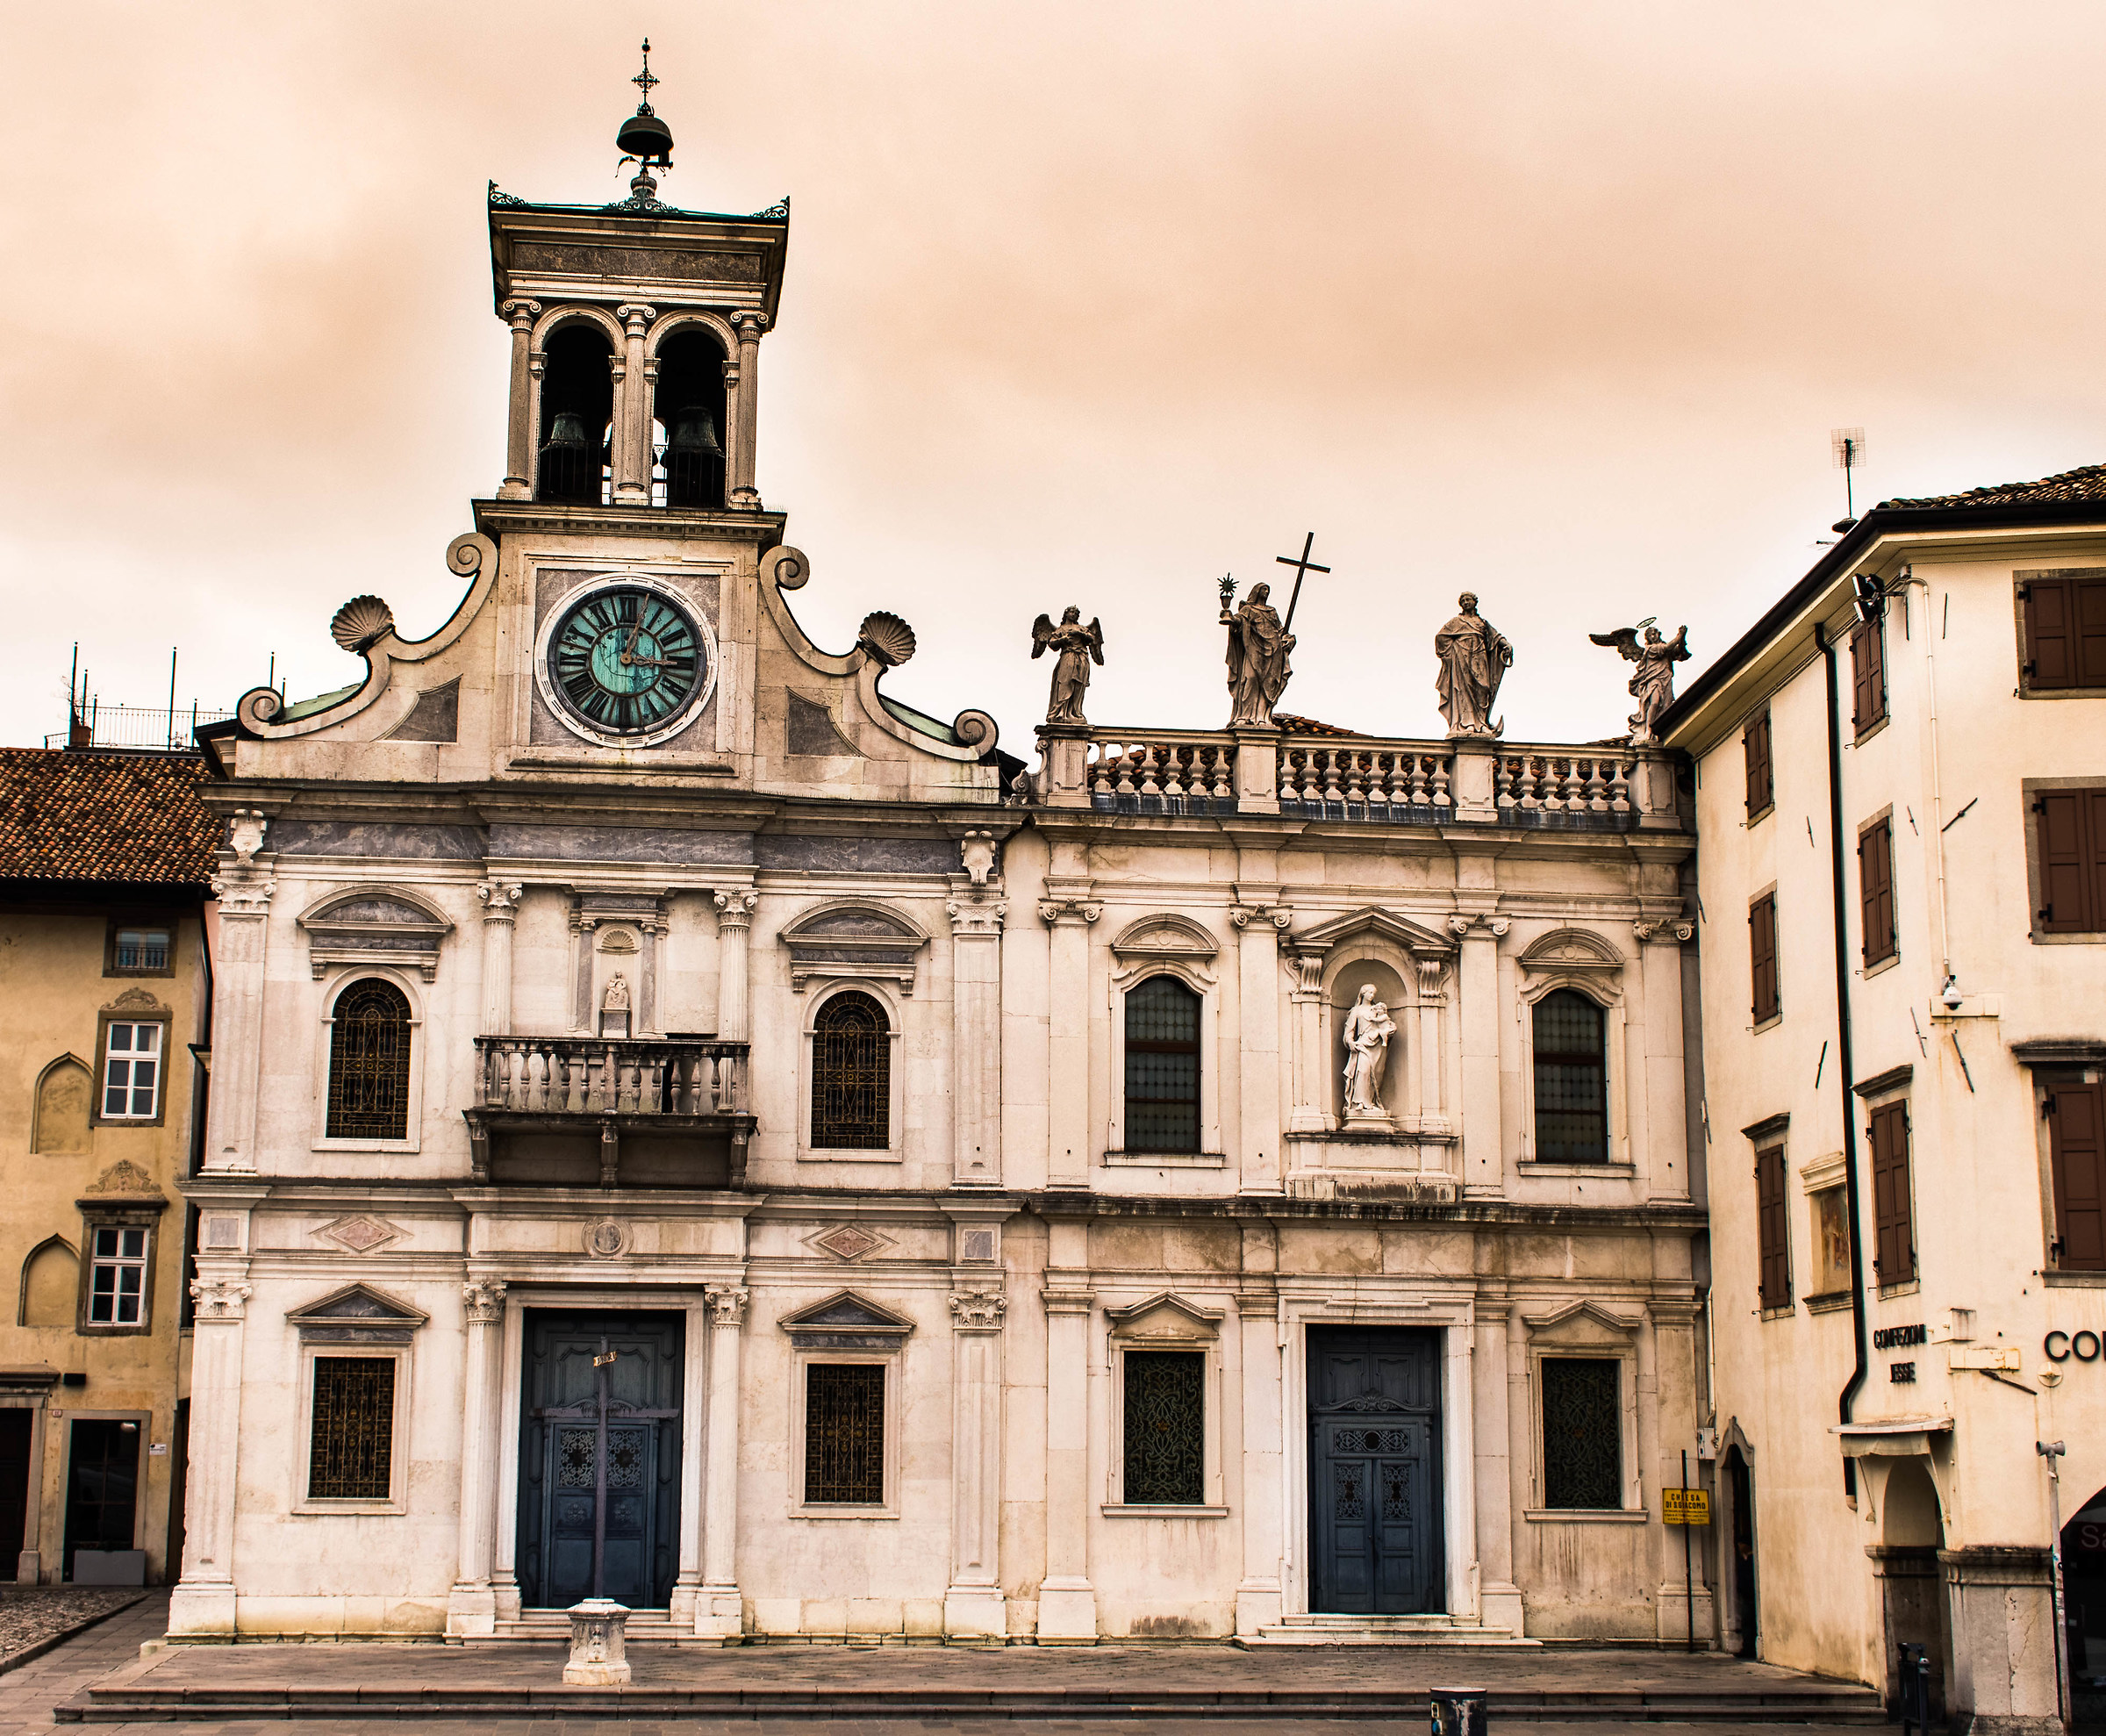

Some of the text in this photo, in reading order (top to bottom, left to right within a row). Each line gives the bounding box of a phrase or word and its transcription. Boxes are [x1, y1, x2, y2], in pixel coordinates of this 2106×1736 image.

[588, 601, 613, 630] XI
[620, 597, 638, 623] XII
[646, 606, 664, 630] I
[567, 623, 595, 645] X
[659, 627, 688, 648] II
[559, 651, 588, 668] IX
[1873, 1324, 1927, 1350] CONFEZIONI
[1889, 1361, 1916, 1384] JESSE
[1671, 1493, 1701, 1502] CHIESA
